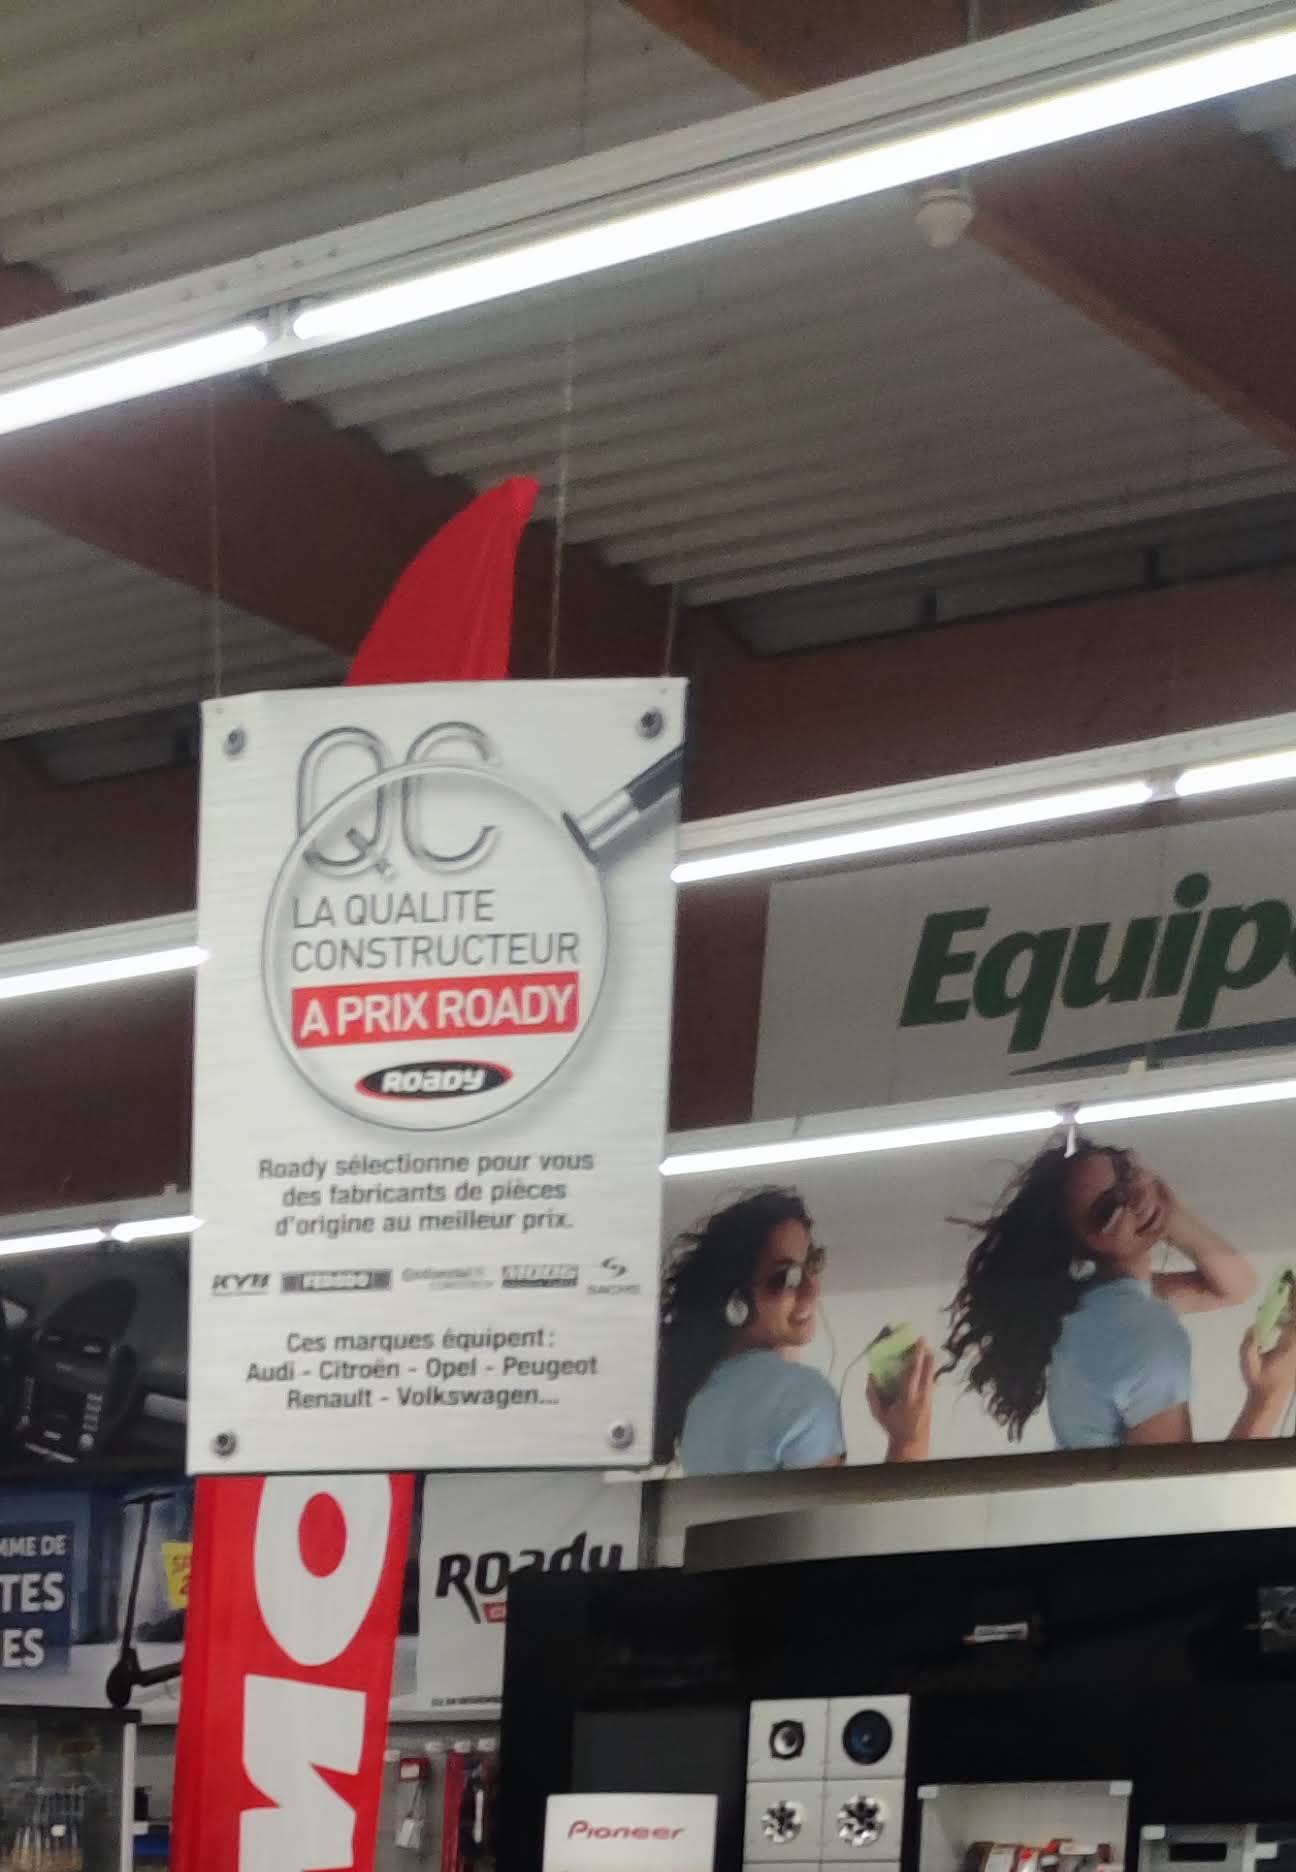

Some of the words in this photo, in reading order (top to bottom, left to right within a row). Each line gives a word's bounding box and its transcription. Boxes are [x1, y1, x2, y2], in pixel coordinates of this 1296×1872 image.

[292, 896, 336, 929] LA
[344, 888, 495, 926] QUALITE
[292, 931, 580, 973] CONSTRUCTEUR
[899, 872, 1296, 1054] Equip
[300, 998, 330, 1040] A
[336, 991, 428, 1036] PRIX
[436, 983, 576, 1029] ROADY
[258, 1158, 327, 1181] Roady
[335, 1153, 470, 1177] sélectionne
[477, 1153, 531, 1177] pour
[539, 1152, 594, 1171] vous
[281, 1187, 322, 1208] des
[329, 1182, 446, 1205] fabricants
[454, 1180, 482, 1202] de
[490, 1178, 567, 1205] pièces
[275, 1215, 376, 1240] d'origine
[383, 1215, 411, 1233] au
[418, 1209, 515, 1231] meilleur
[521, 1208, 575, 1234] prix.
[286, 1332, 327, 1352] Ces
[334, 1330, 434, 1356] marques
[246, 1361, 296, 1381] Audi
[319, 1357, 401, 1381] Citroën
[425, 1357, 478, 1381] Opel
[502, 1355, 599, 1381] Peugeot
[286, 1388, 373, 1410] Renault
[40, 1534, 68, 1556] DE
[567, 1819, 686, 1841] Pioneer
